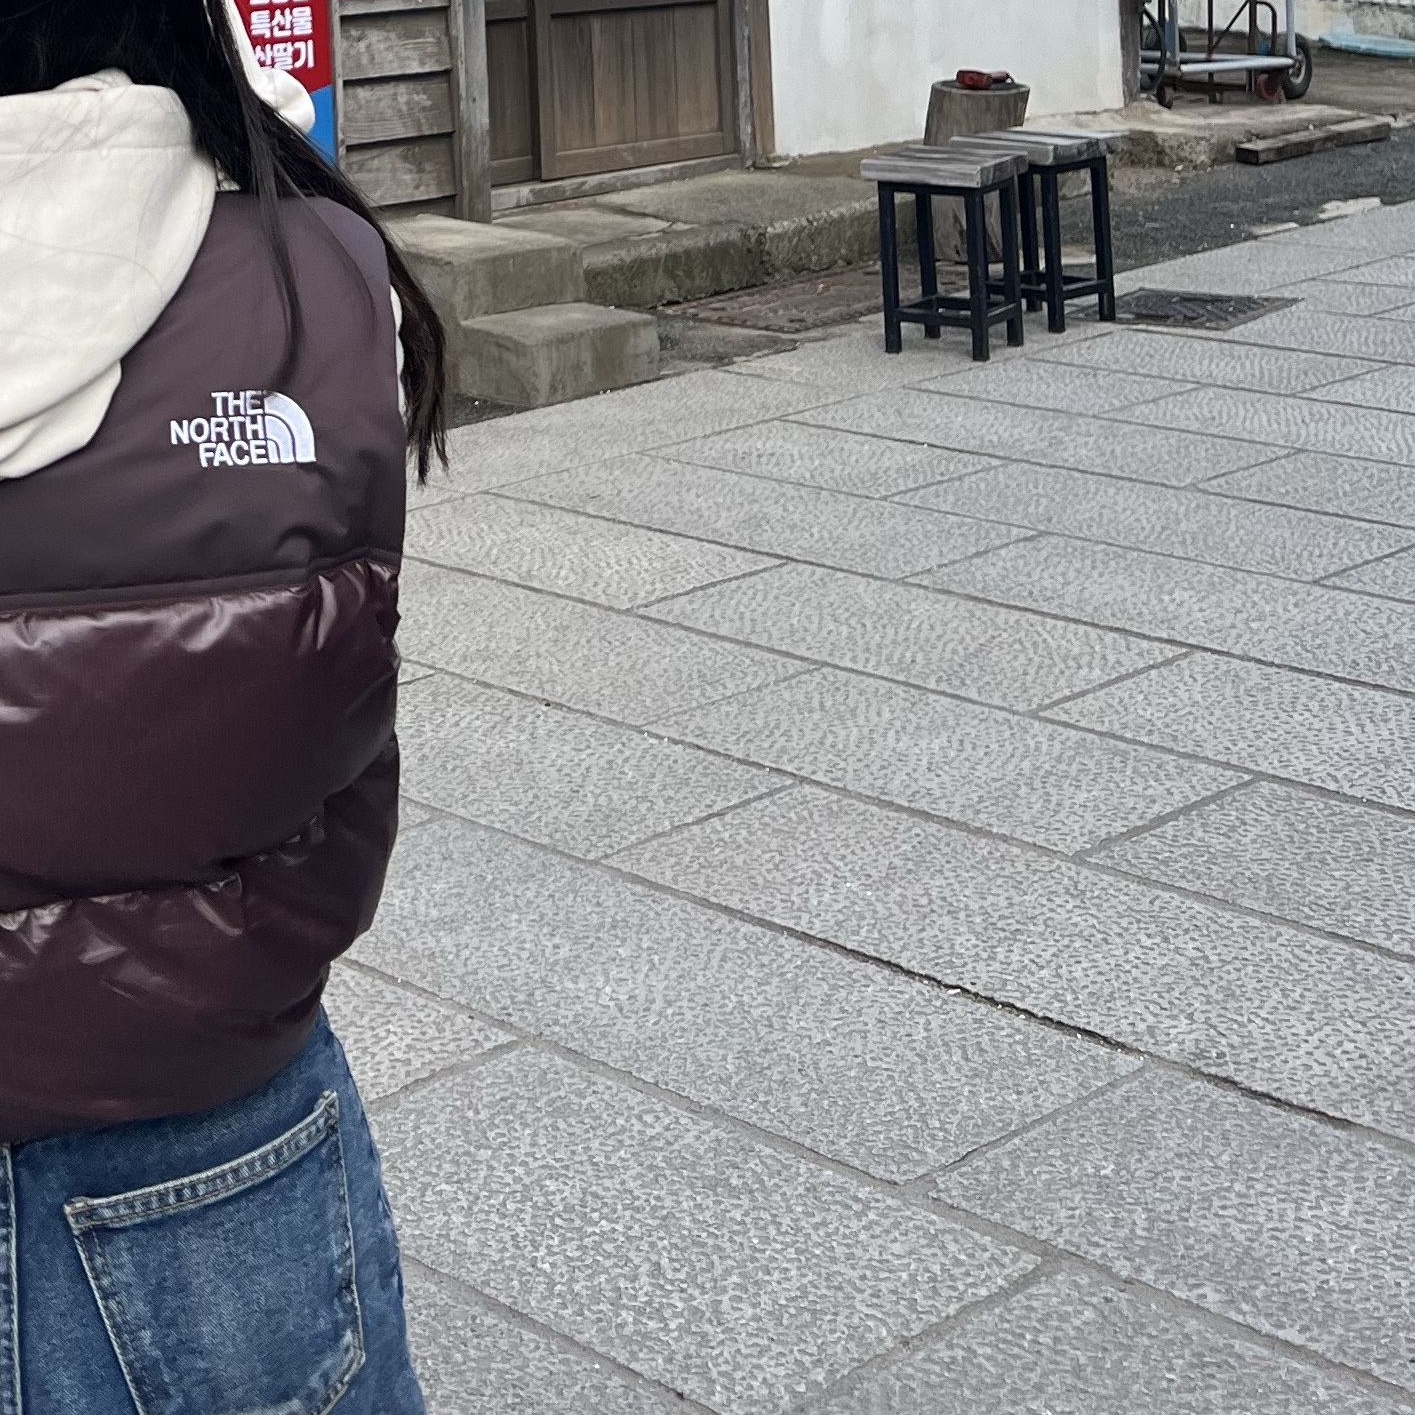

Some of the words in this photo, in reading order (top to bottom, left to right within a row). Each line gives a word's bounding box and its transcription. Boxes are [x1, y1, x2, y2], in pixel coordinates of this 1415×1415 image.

[250, 5, 313, 38] 특산물
[211, 390, 264, 416] THE
[170, 415, 264, 445] NORTH
[199, 440, 268, 467] FACE
